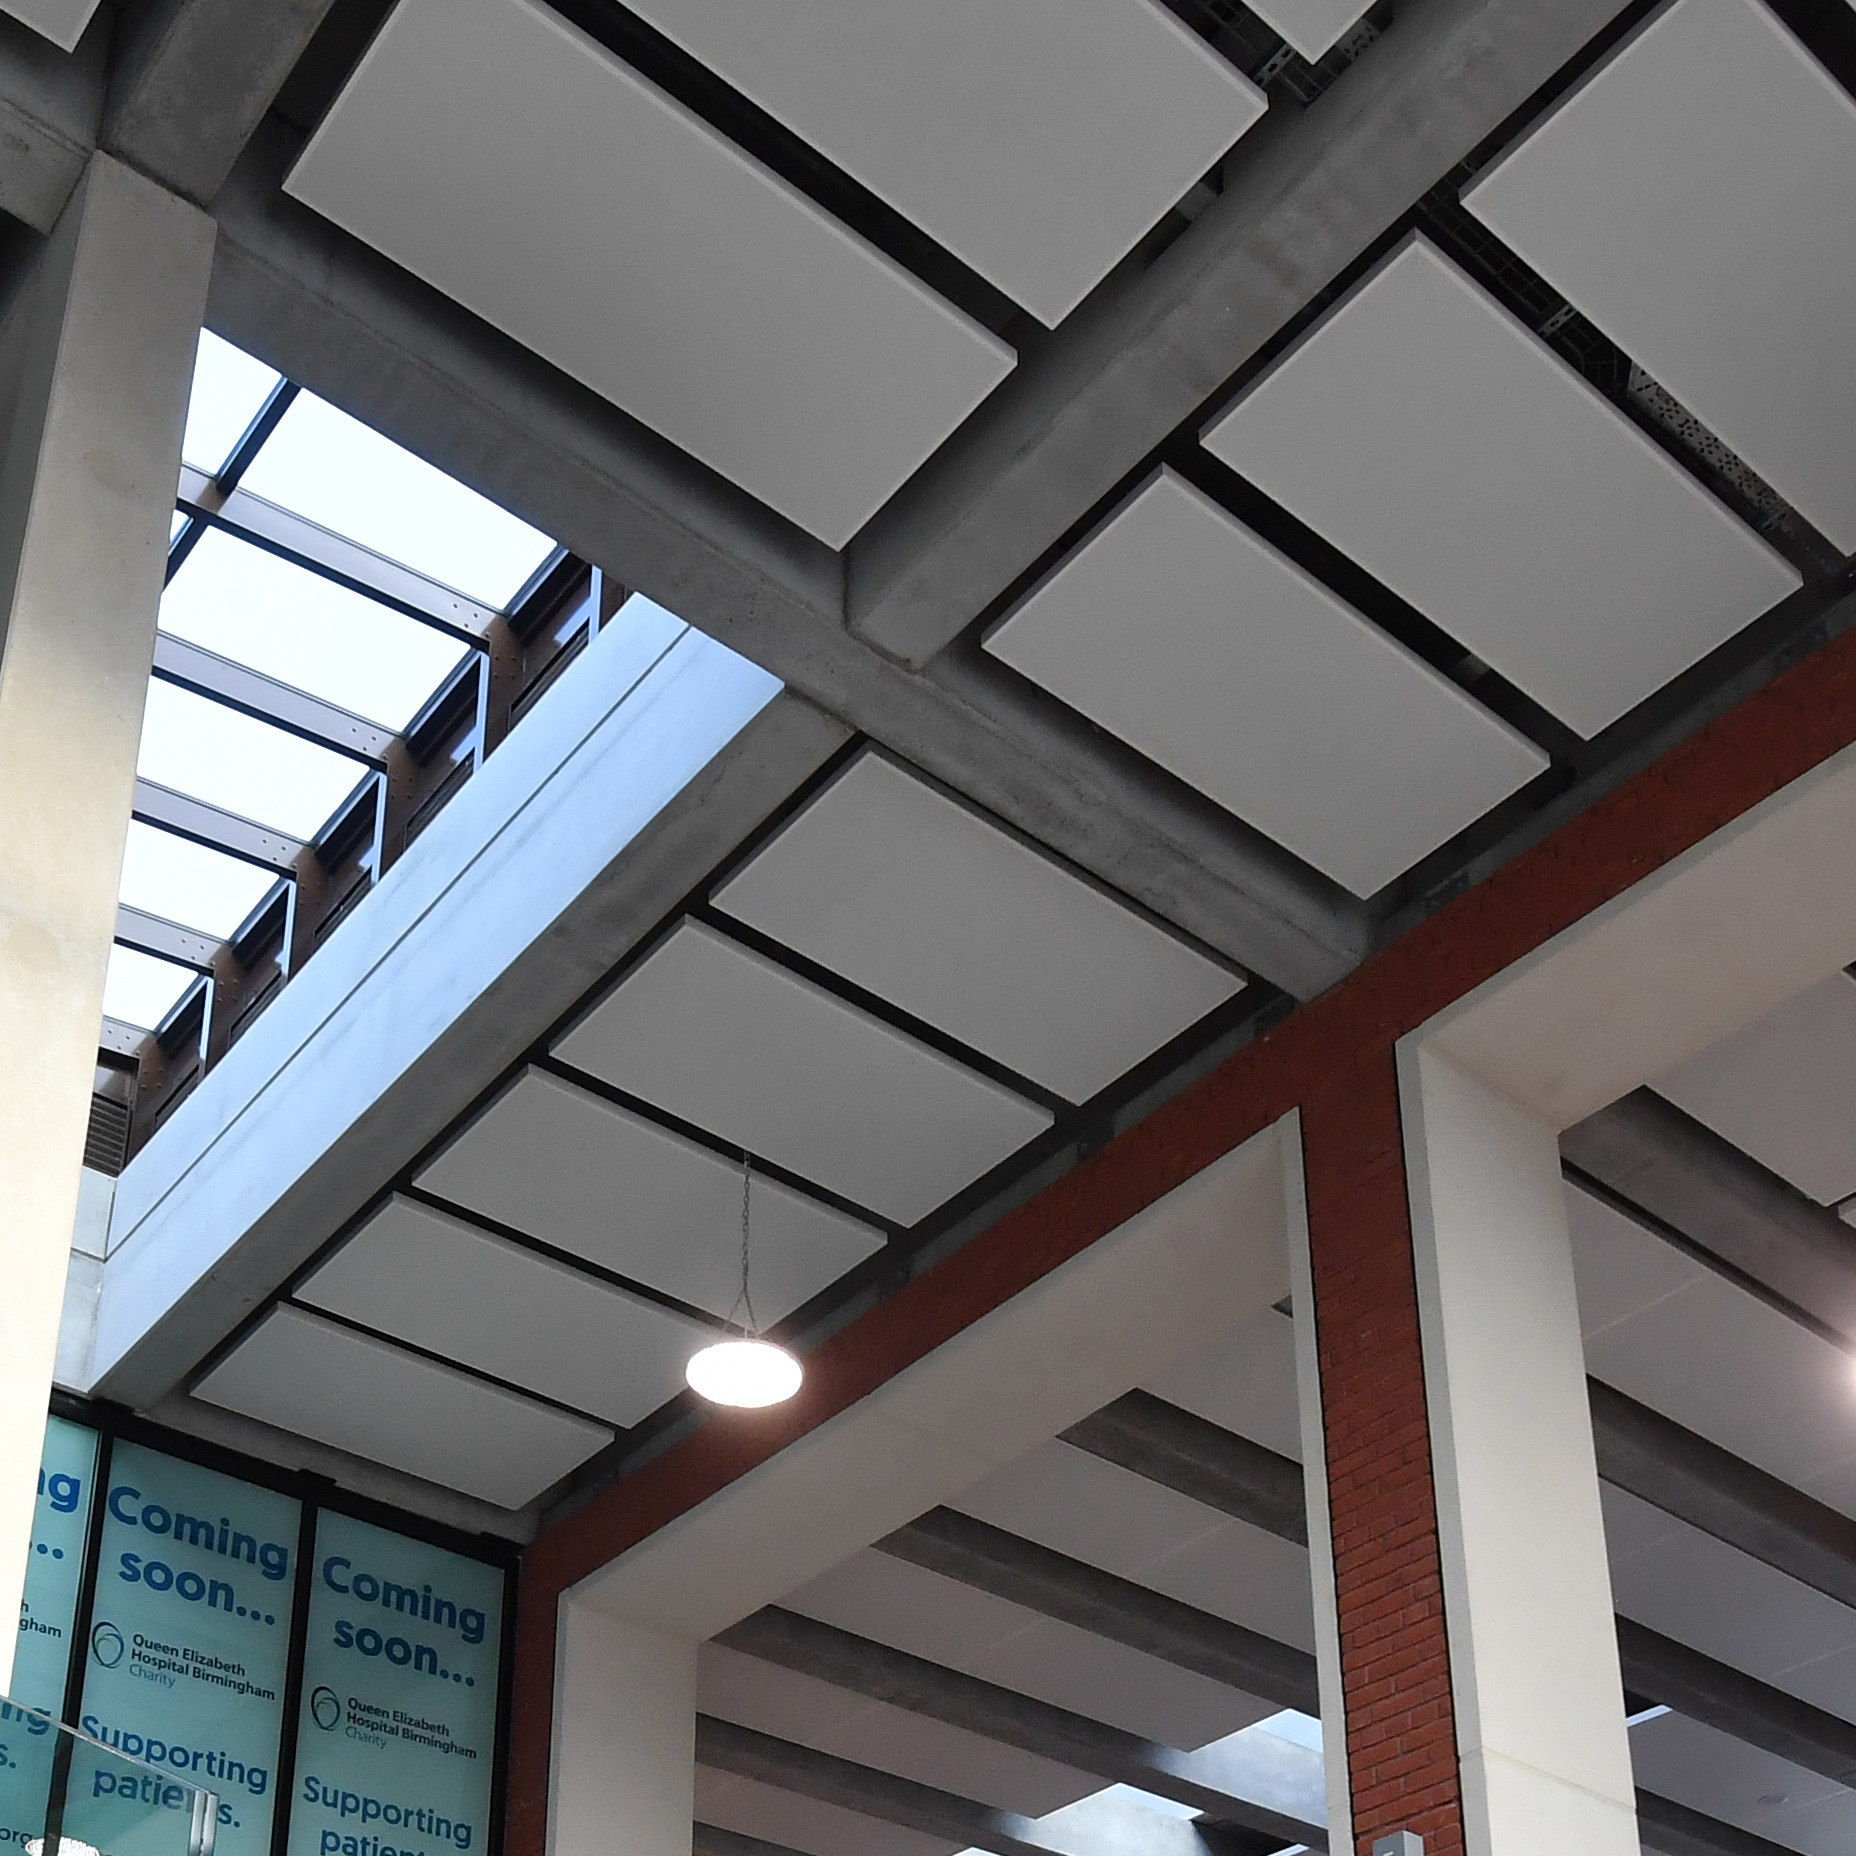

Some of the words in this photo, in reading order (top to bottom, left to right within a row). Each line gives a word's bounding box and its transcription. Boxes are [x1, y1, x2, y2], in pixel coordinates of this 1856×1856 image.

[108, 1485, 289, 1581] Coming
[117, 1553, 276, 1626] soon...
[323, 1556, 486, 1645] Coming
[129, 1664, 176, 1689] Charity
[131, 1649, 189, 1676] Hospital
[193, 1666, 275, 1700] Birmingham
[133, 1634, 179, 1658] Queen
[182, 1648, 245, 1677] Elizabeth
[334, 1620, 475, 1688] soon...
[345, 1726, 387, 1750] Charity
[346, 1711, 399, 1737] Hospital
[402, 1728, 477, 1759] Birmingham
[348, 1697, 390, 1720] Queen
[392, 1710, 450, 1737] Elizabeth
[82, 1715, 268, 1796] Supporting
[92, 1769, 241, 1828] paties.
[303, 1776, 473, 1850] Supporting
